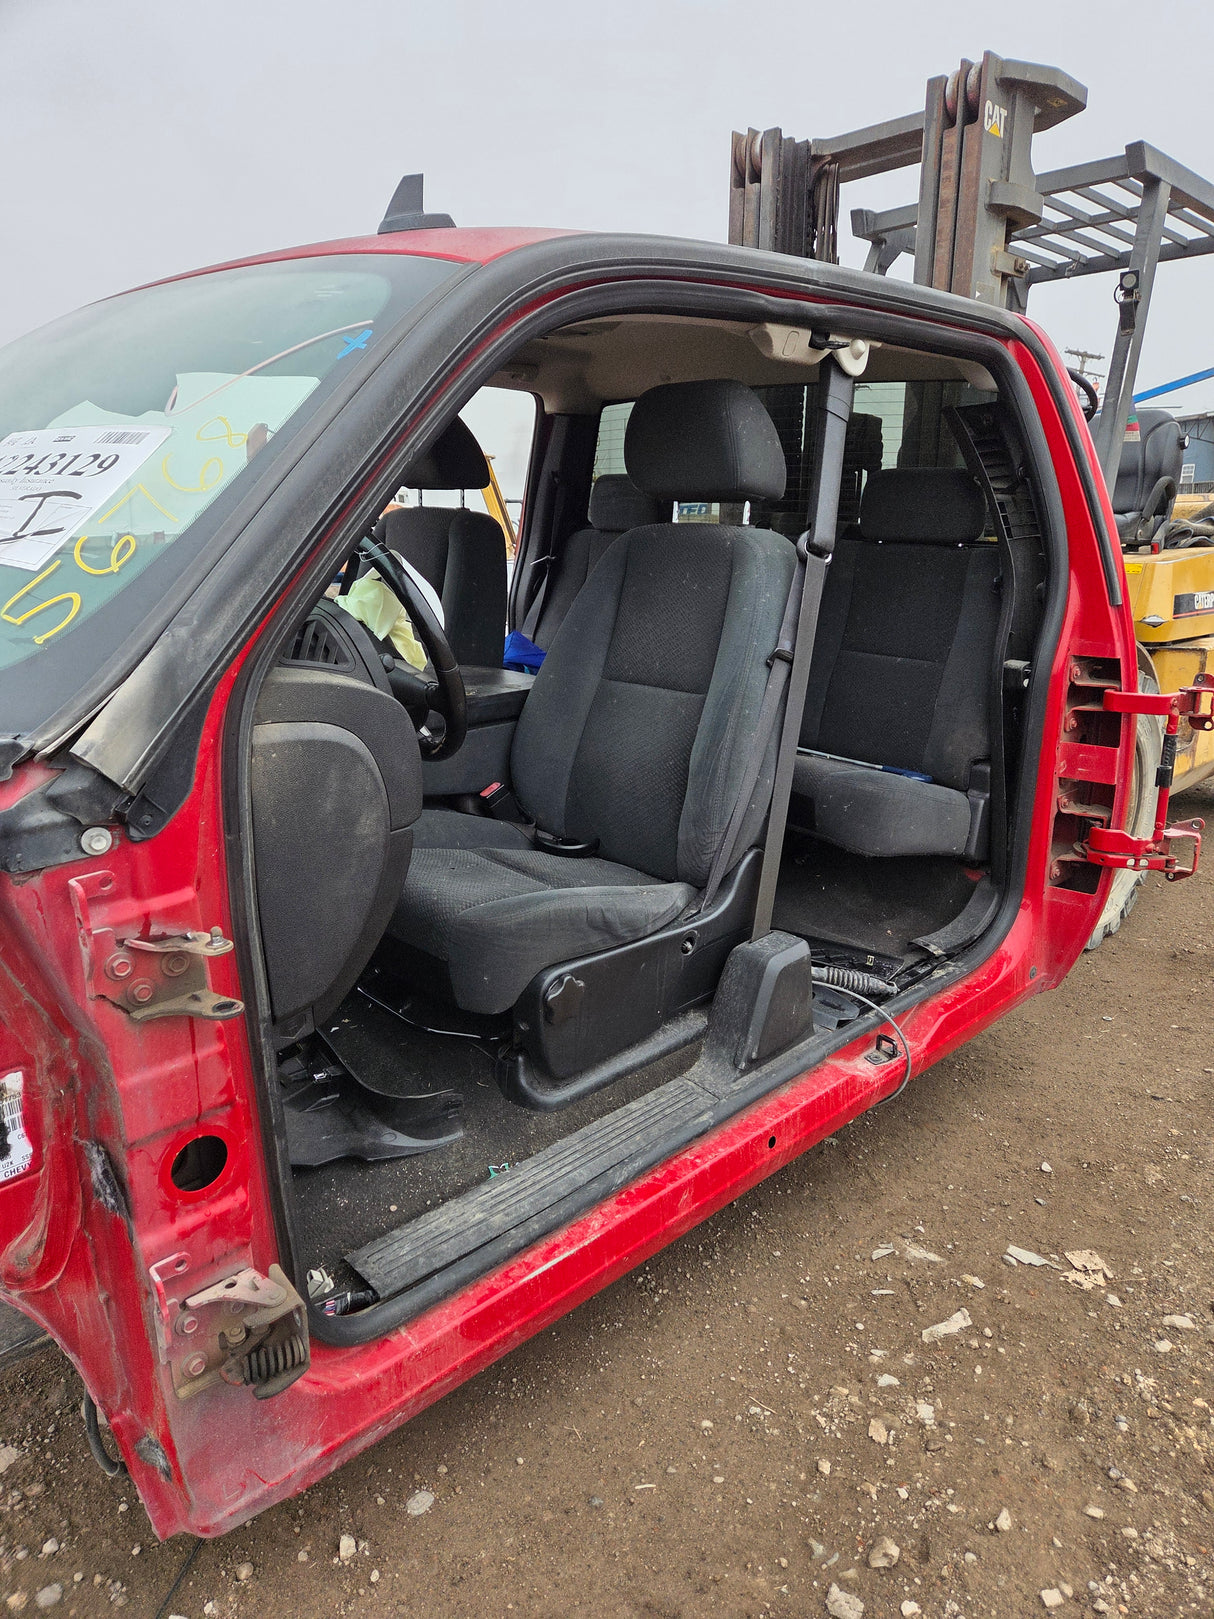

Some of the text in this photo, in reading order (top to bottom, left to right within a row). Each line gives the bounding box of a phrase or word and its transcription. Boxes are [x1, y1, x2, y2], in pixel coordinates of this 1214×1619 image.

[984, 100, 1008, 139] CAT
[0, 453, 120, 477] 2243129
[4, 1161, 32, 1178] CHEVY
